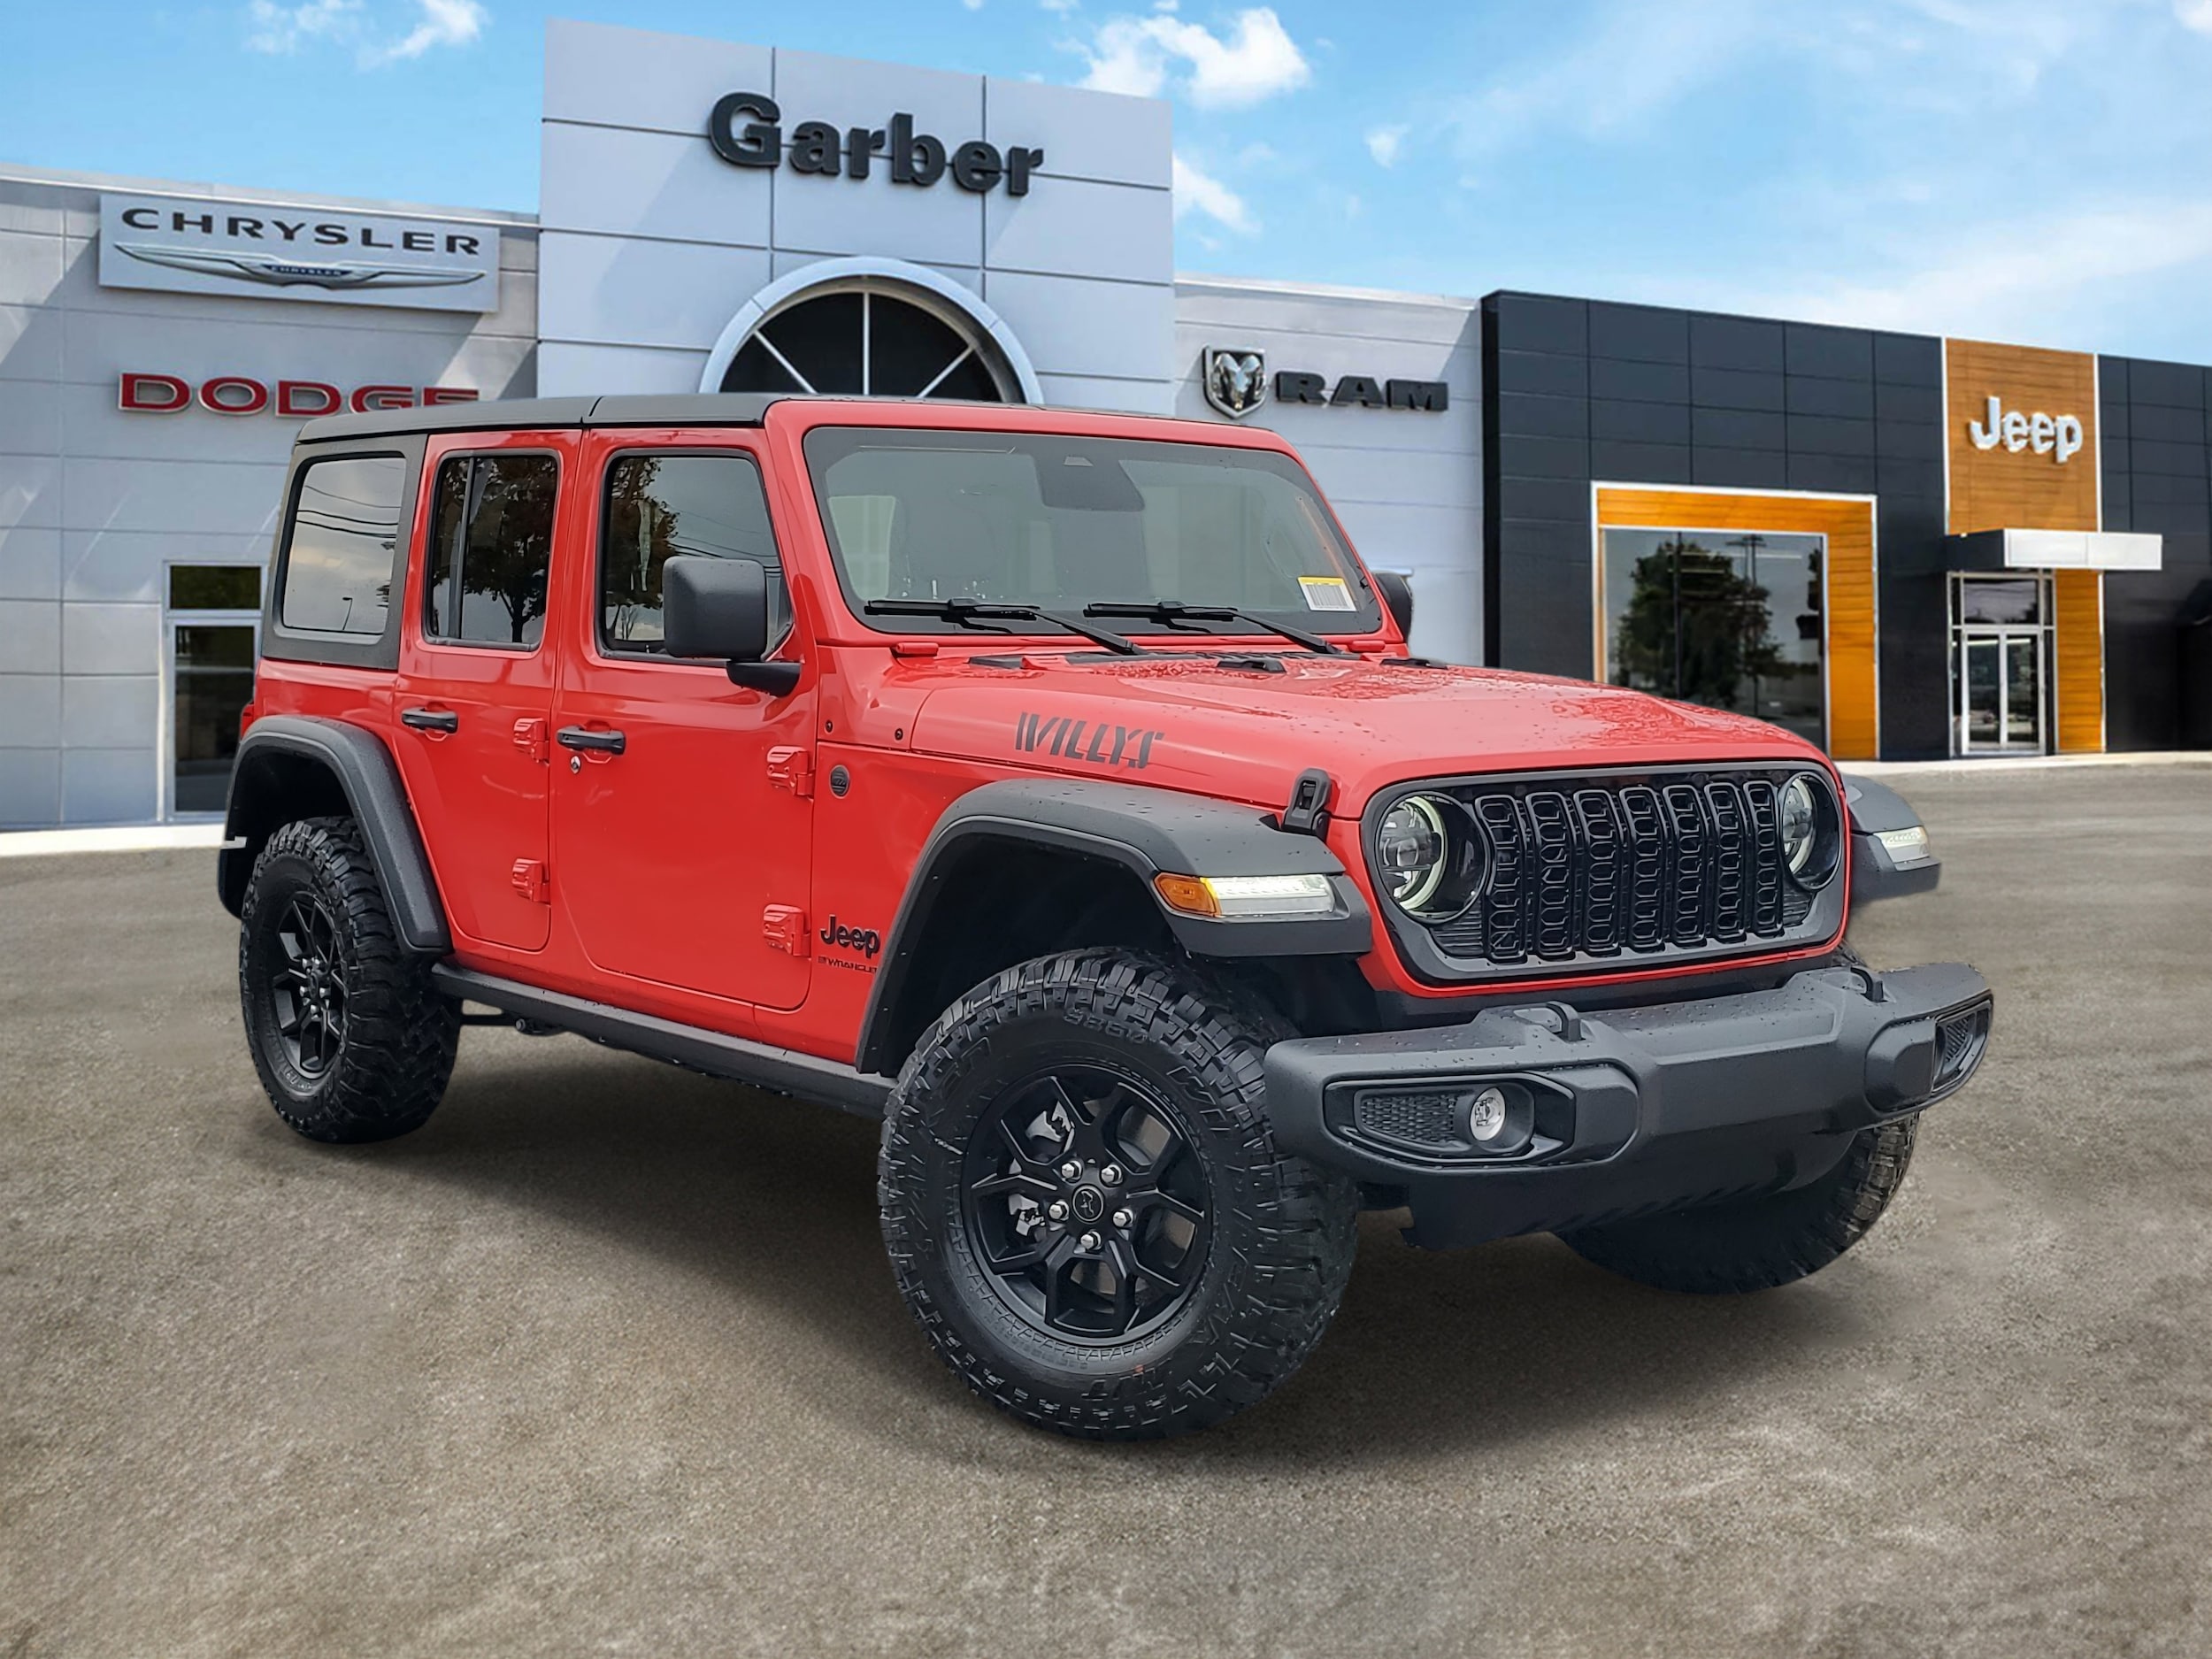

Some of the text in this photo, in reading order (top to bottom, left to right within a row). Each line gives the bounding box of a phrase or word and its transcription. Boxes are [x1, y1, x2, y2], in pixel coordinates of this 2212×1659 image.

[708, 91, 1044, 197] Garber
[121, 207, 480, 256] CHRYSLER
[1275, 370, 1448, 412] RAM
[1969, 396, 2083, 464] Jeep
[1015, 711, 1164, 769] WILLYS
[820, 913, 880, 960] Jeep
